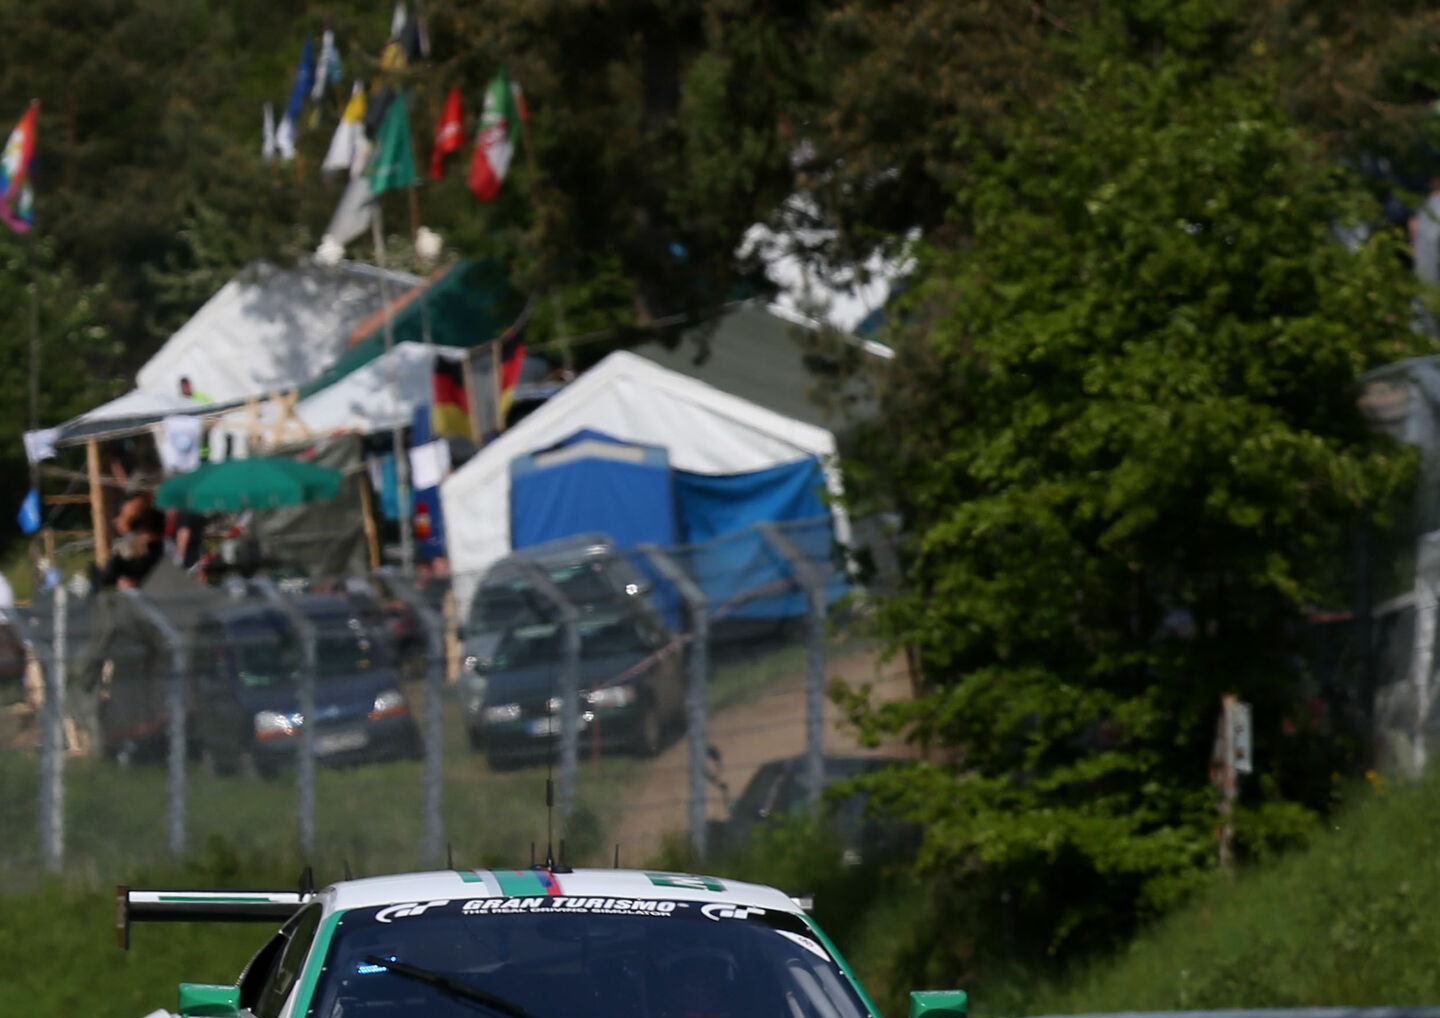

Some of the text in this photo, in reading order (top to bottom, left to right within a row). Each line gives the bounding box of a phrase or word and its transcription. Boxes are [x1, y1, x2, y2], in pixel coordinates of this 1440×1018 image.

[462, 897, 676, 912] GRAN TURISMO
[591, 907, 672, 917] SIMULATOR
